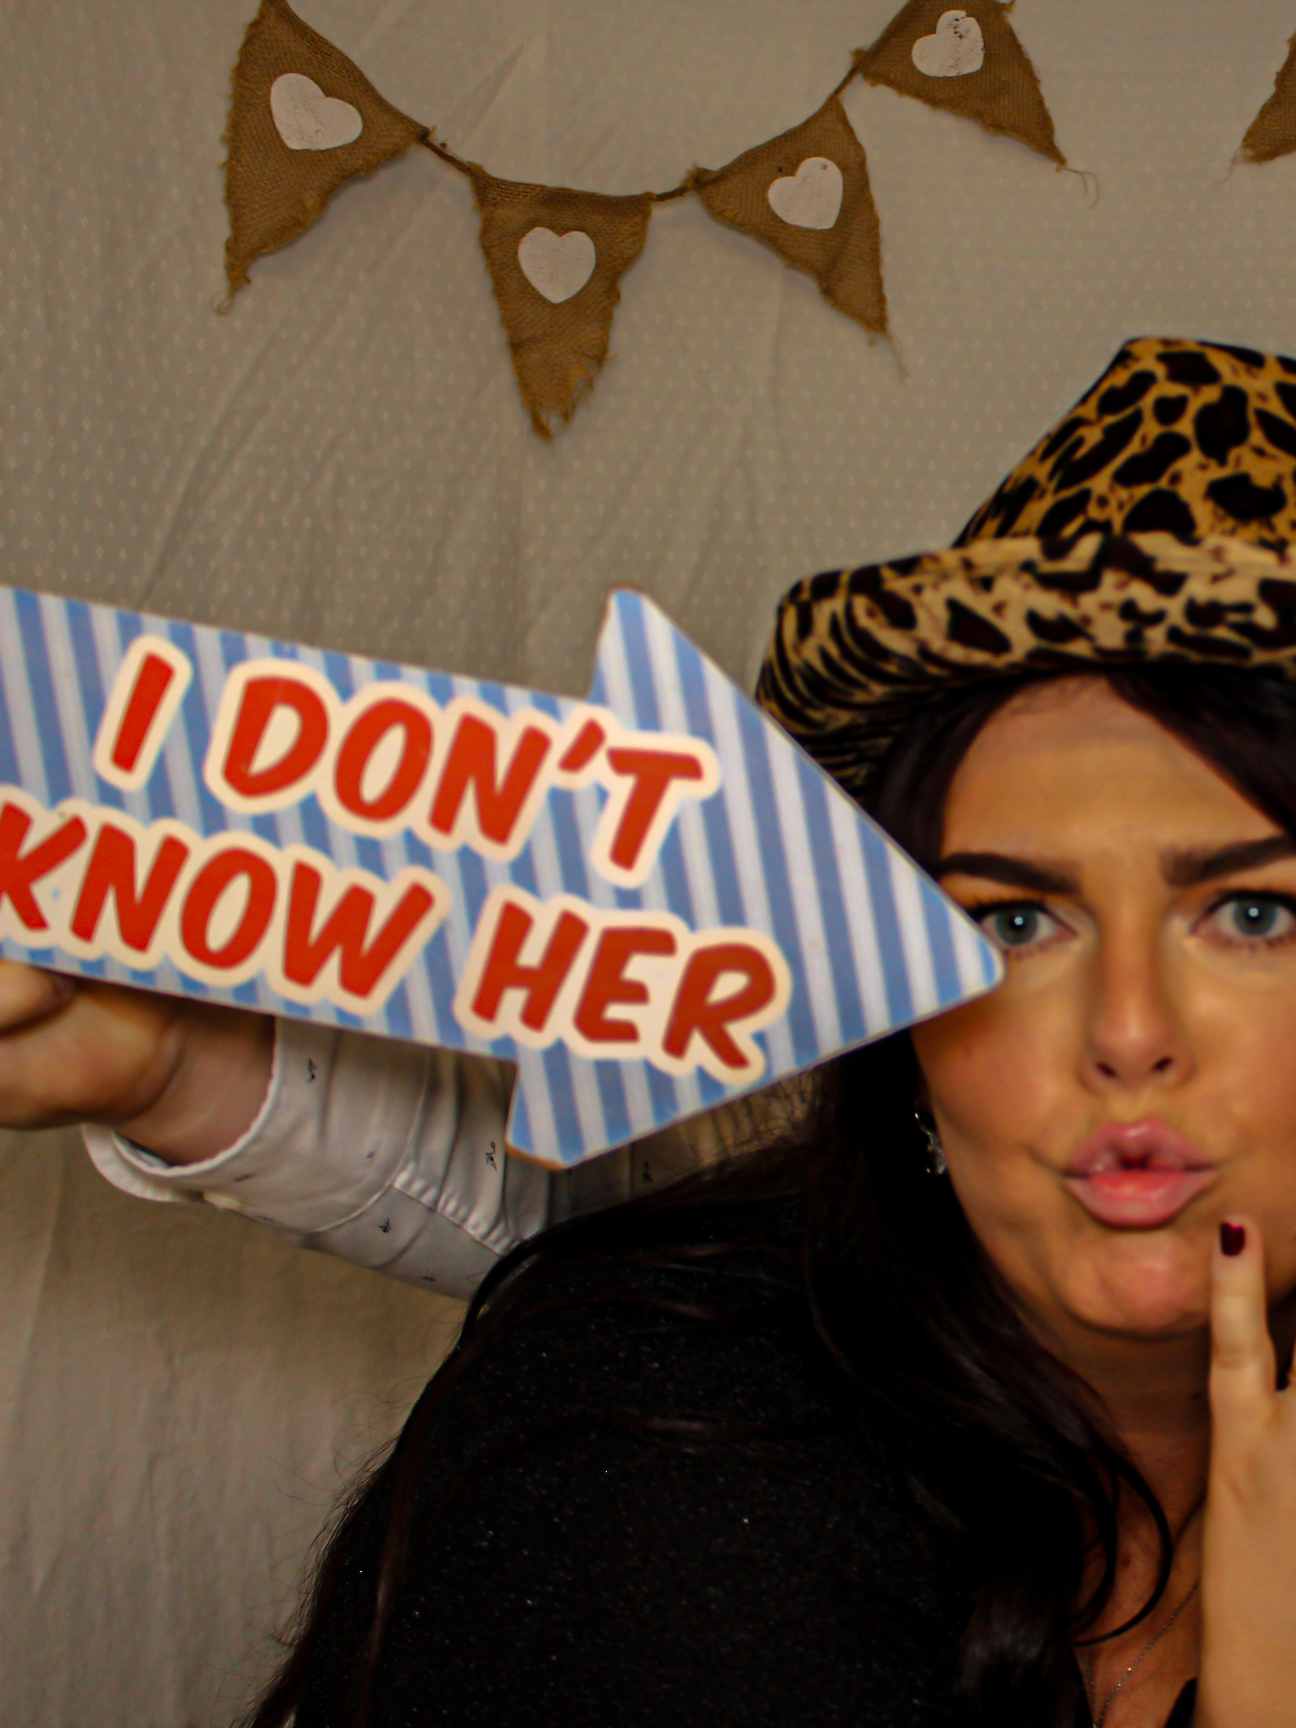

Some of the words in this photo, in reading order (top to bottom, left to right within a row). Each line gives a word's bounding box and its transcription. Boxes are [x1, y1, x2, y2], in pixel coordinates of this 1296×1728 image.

[108, 648, 177, 777] I
[220, 673, 706, 873] DON'T
[0, 800, 437, 1003] KNOW
[469, 898, 779, 1071] HER
